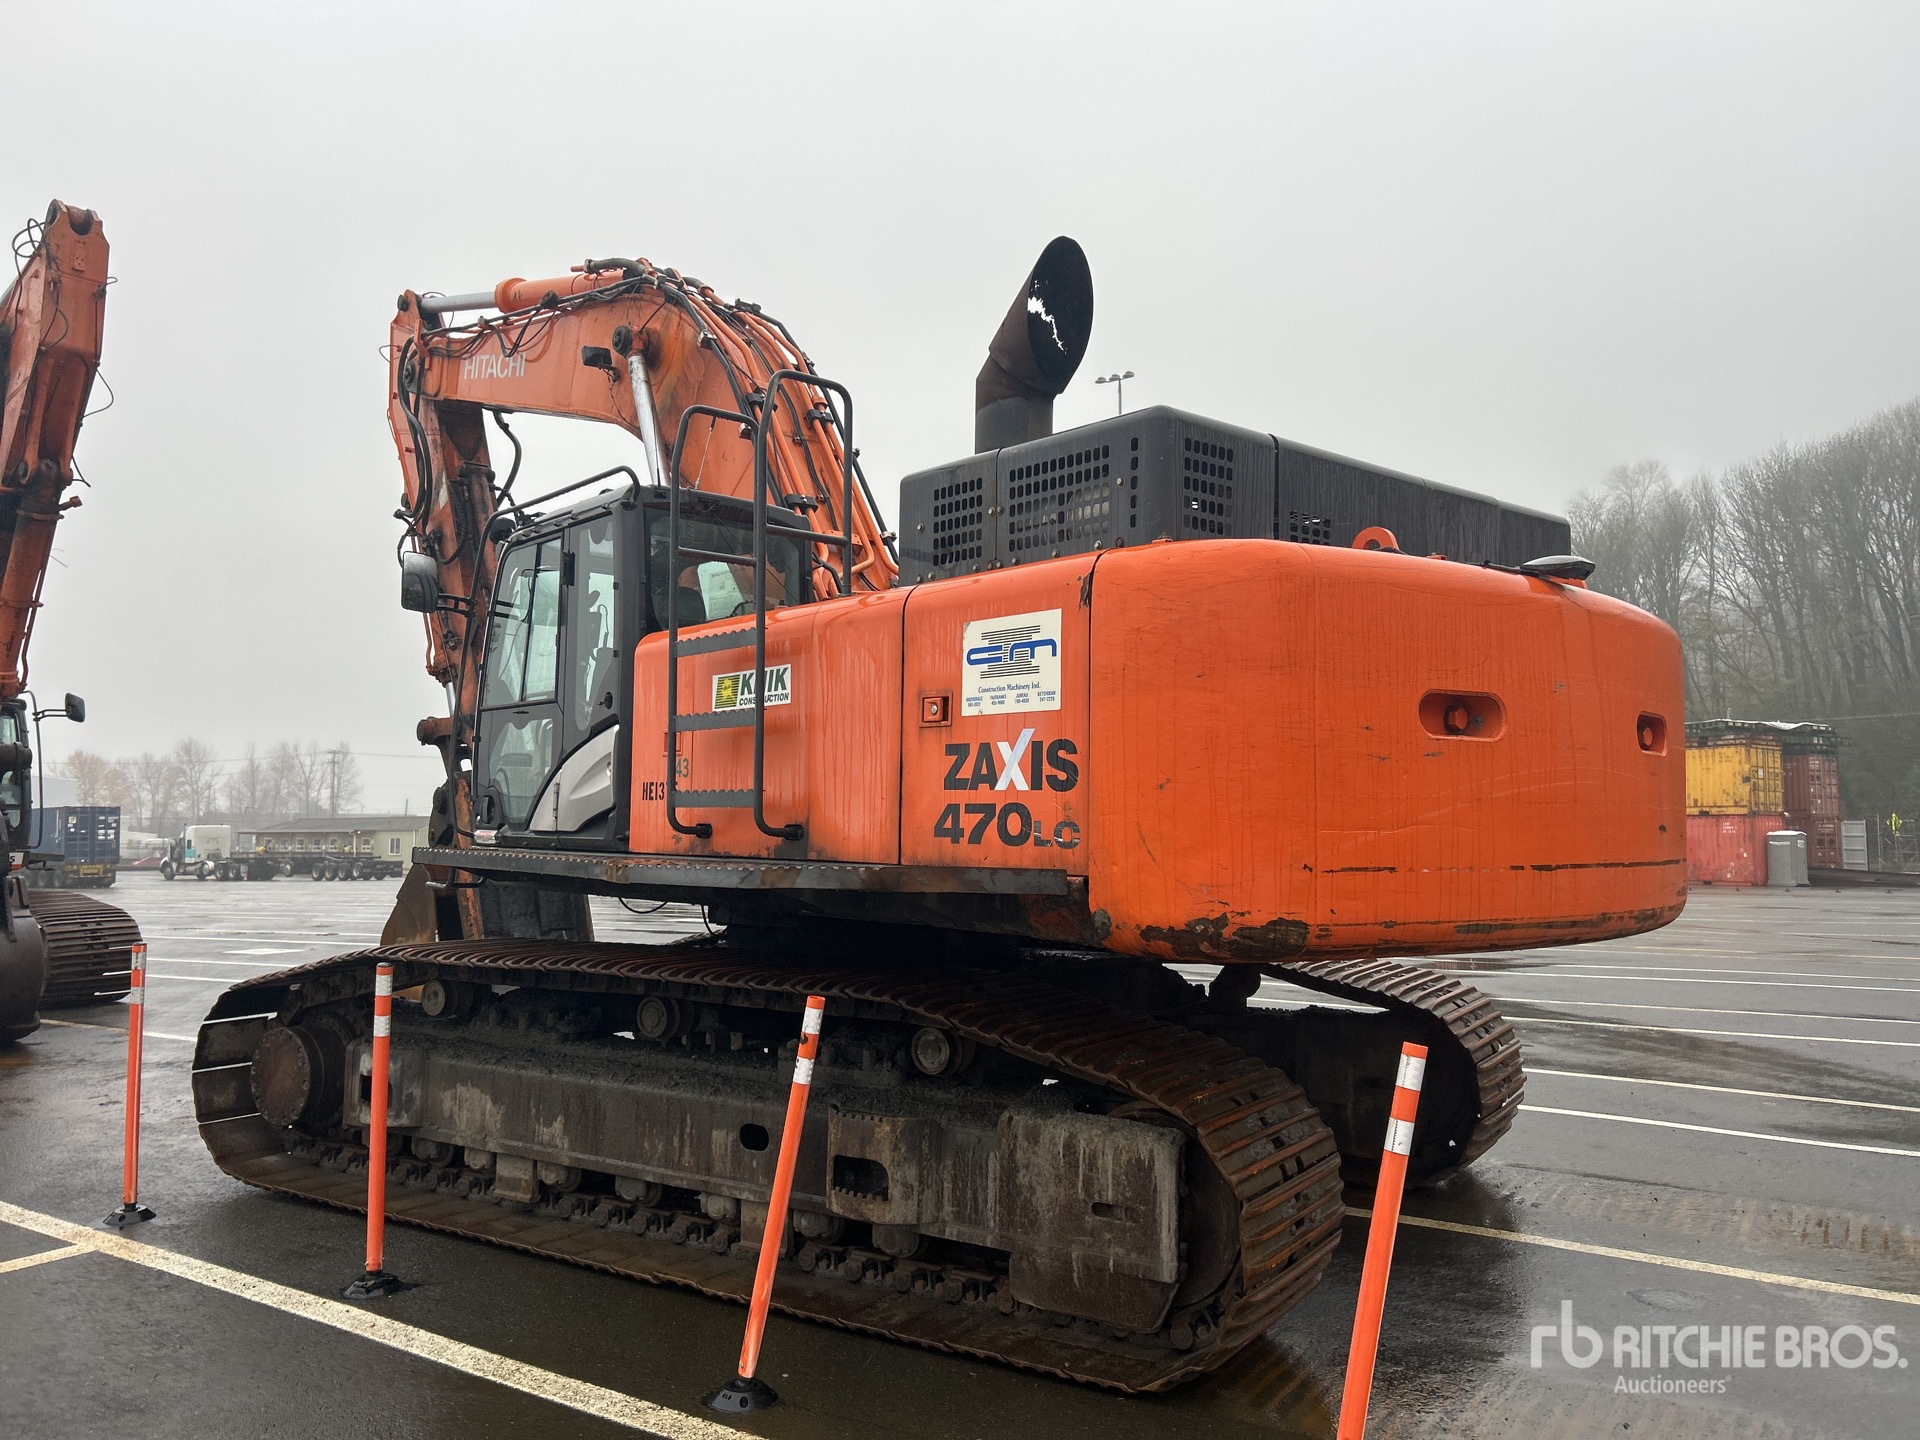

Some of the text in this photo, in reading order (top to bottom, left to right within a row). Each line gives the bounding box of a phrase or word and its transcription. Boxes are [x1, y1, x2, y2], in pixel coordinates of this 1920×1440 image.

[463, 353, 527, 380] HITACHI
[740, 667, 789, 696] KIK
[1007, 683, 1030, 691] Machinery
[739, 693, 789, 706] CONSUCTION
[944, 728, 1079, 792] ZAXIS
